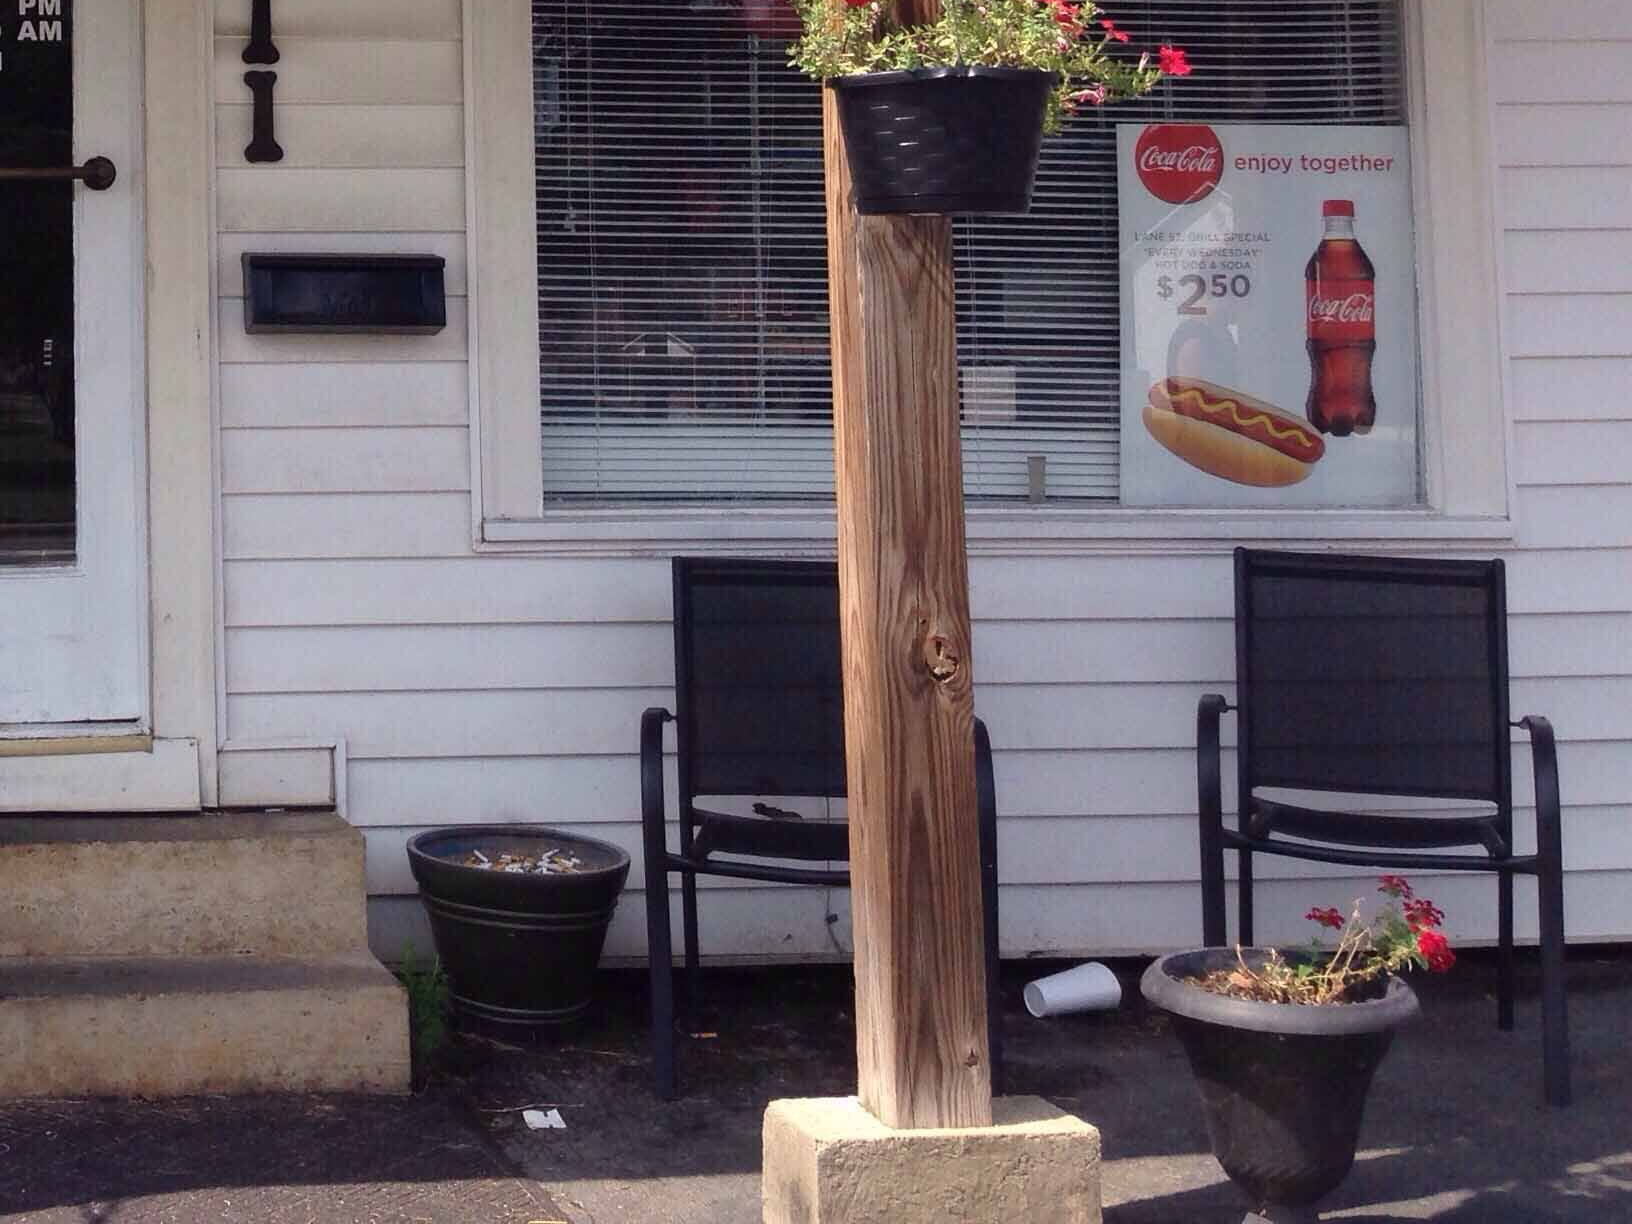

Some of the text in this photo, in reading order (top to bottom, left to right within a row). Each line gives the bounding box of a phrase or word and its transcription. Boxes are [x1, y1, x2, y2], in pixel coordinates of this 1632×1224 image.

[17, 21, 62, 41] AM
[1140, 145, 1218, 172] Coca-Cola
[1234, 154, 1394, 174] enjoy together
